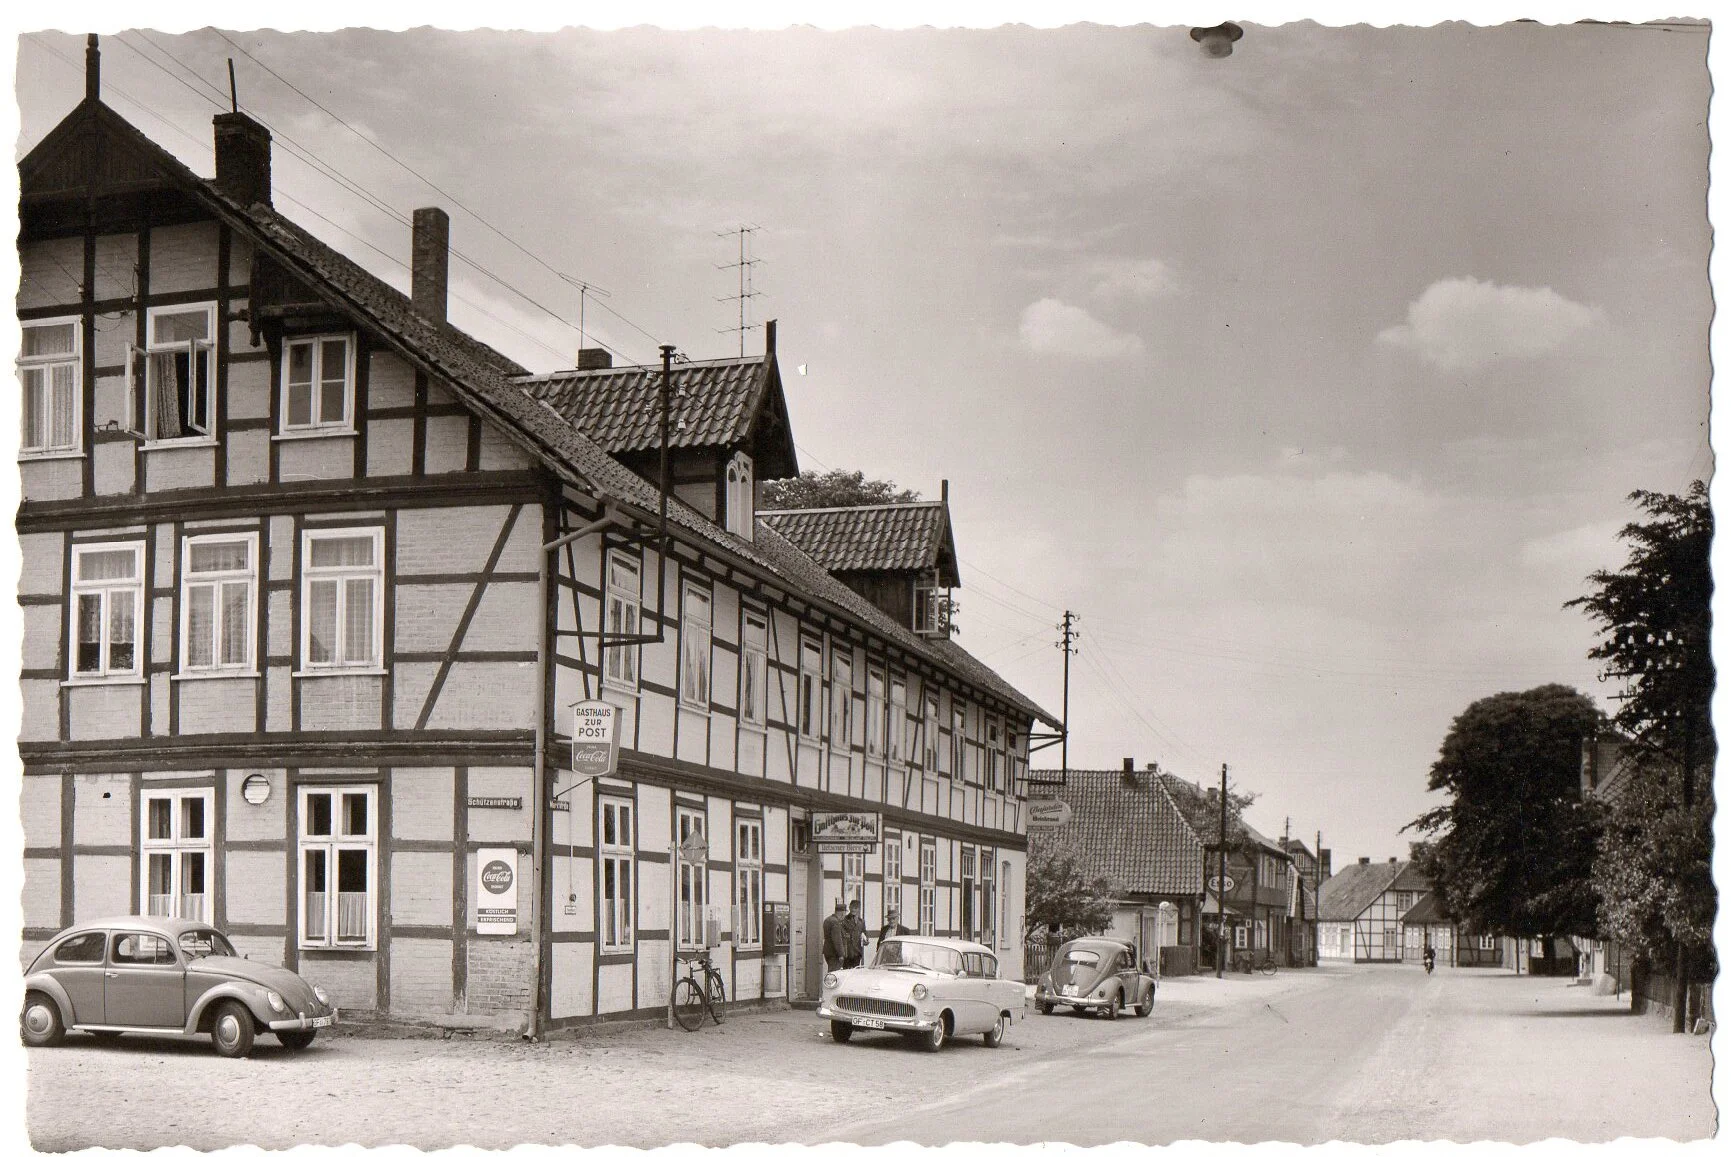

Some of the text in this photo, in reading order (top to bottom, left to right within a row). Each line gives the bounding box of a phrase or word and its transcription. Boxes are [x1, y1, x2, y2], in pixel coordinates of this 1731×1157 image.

[576, 708, 611, 717] GASTHAUS
[585, 718, 602, 726] ZUR
[578, 727, 607, 738] POST
